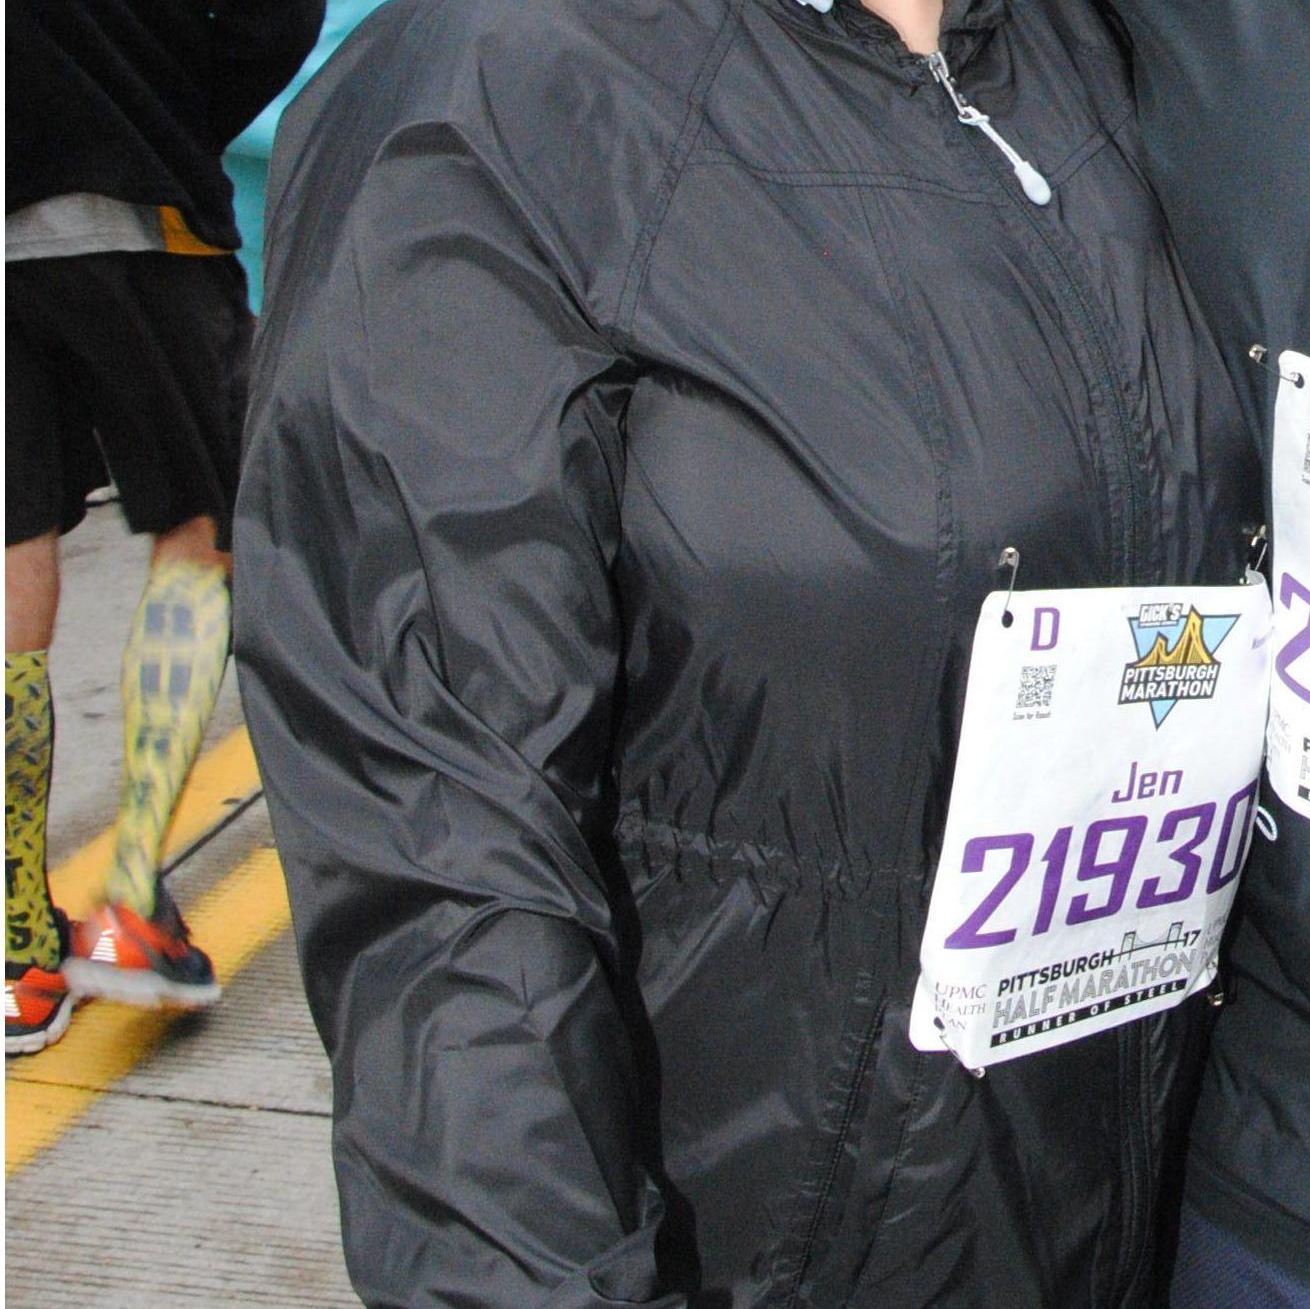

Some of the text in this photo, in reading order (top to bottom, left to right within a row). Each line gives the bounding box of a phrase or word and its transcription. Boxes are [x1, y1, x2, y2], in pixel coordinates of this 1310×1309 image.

[1030, 607, 1061, 652] D
[1121, 680, 1214, 702] MARATHON
[1124, 664, 1218, 684] PITTSBURGH
[1111, 761, 1184, 803] Jen
[944, 778, 1258, 949] 21930
[992, 949, 1198, 1029] HALF MARATHON
[997, 948, 1115, 997] PITTSBURGH
[999, 980, 1178, 1045] RUNNER OF STEEL
